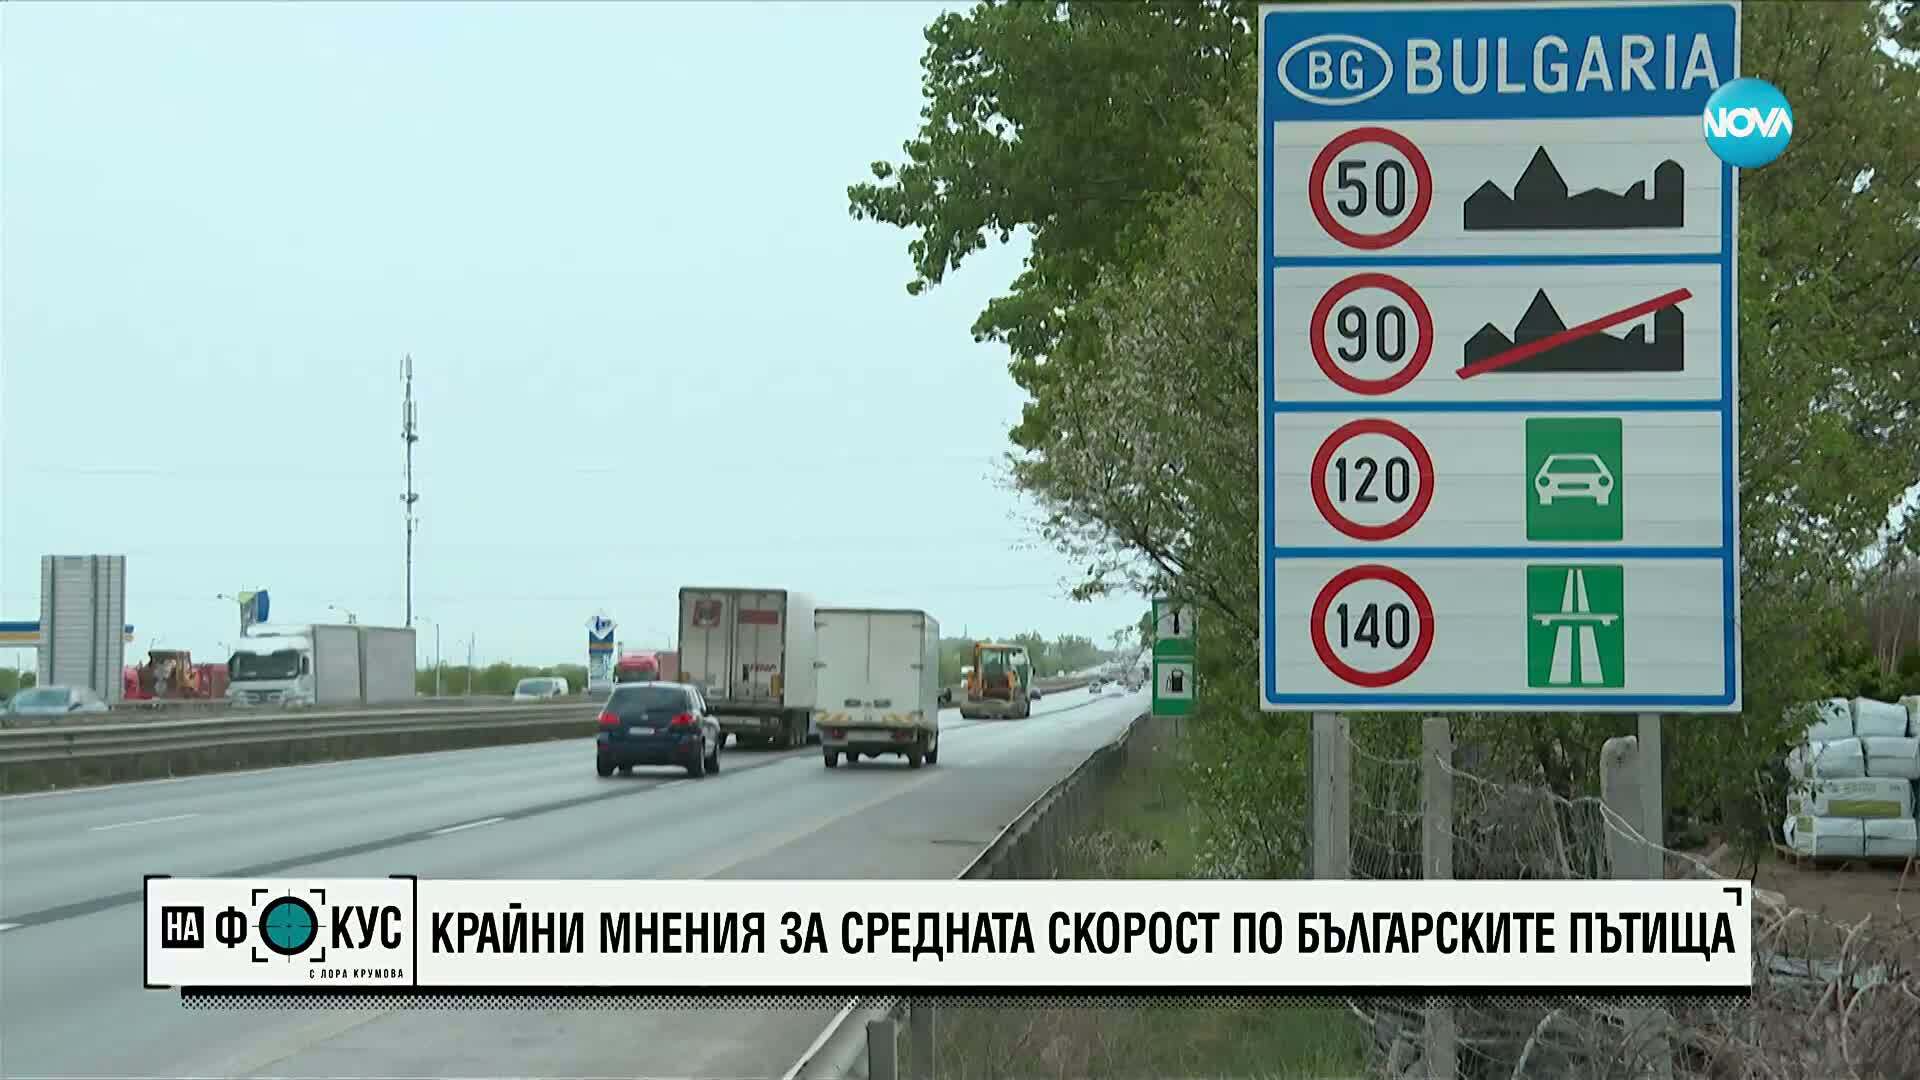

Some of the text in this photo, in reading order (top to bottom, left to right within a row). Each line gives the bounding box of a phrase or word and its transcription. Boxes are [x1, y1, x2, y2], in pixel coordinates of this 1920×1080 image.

[1307, 32, 1721, 95] BG BULGARIA
[1336, 159, 1407, 218] 50
[1336, 305, 1407, 363] 90
[1335, 456, 1411, 504] 120
[1336, 601, 1411, 650] 140
